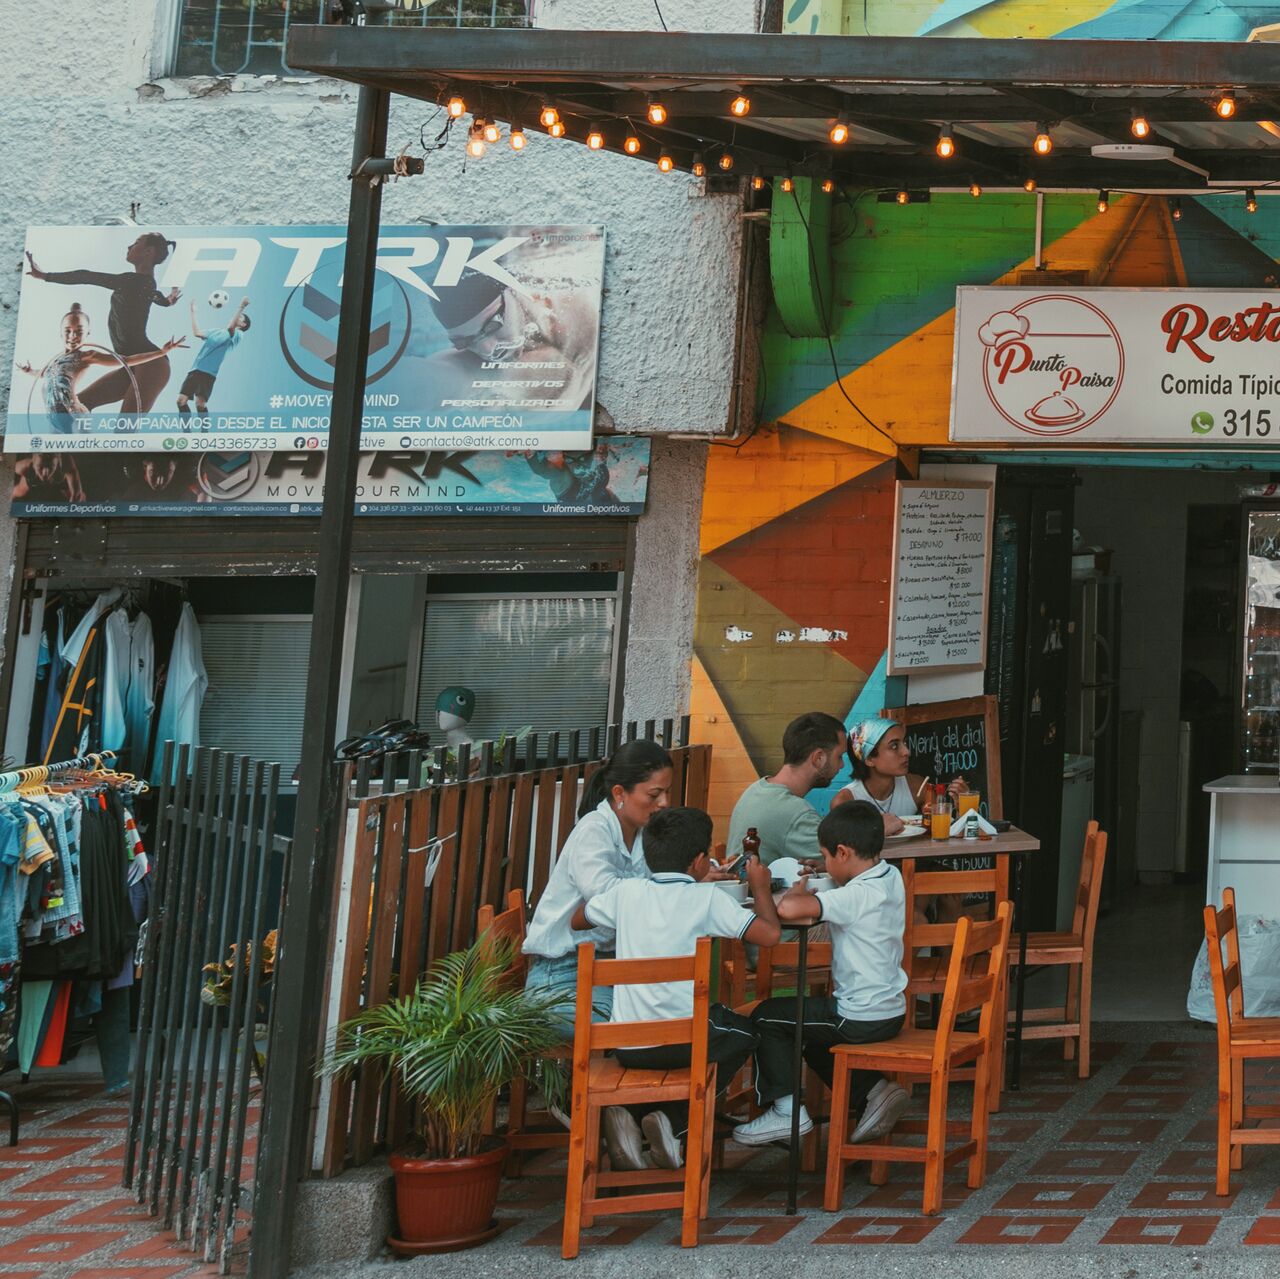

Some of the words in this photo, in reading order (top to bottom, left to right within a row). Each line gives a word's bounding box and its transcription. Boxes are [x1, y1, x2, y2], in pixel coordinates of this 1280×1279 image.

[160, 236, 540, 303] ATRK
[480, 361, 566, 370] UNIFORMES
[993, 342, 1068, 385] Punto
[471, 379, 566, 389] DEPORTIVOS
[1059, 366, 1116, 392] Paisa
[1160, 374, 1234, 397] Comida
[270, 394, 399, 409] #MOVEYMIND
[75, 417, 92, 430] TE
[98, 414, 212, 430] ACOMPAÑAMOS
[217, 416, 265, 429] DESDE
[270, 416, 287, 429] EL
[292, 416, 330, 430] INICIO
[392, 415, 422, 429] SER
[426, 415, 448, 428] UN
[452, 413, 523, 428] CAMPEÓN
[1222, 408, 1271, 438] 315
[44, 437, 145, 450] www.atrk.com.co
[190, 437, 278, 449] 3043365733
[412, 434, 539, 448] contacto@atrk.com.co
[264, 450, 484, 487] ARK
[267, 485, 467, 497] MOVEOURMIND
[25, 504, 68, 513] Uniformes
[70, 504, 116, 514] Deportivos
[542, 504, 586, 513] Uniformes
[587, 504, 630, 514] Deportivos
[942, 724, 960, 749] del
